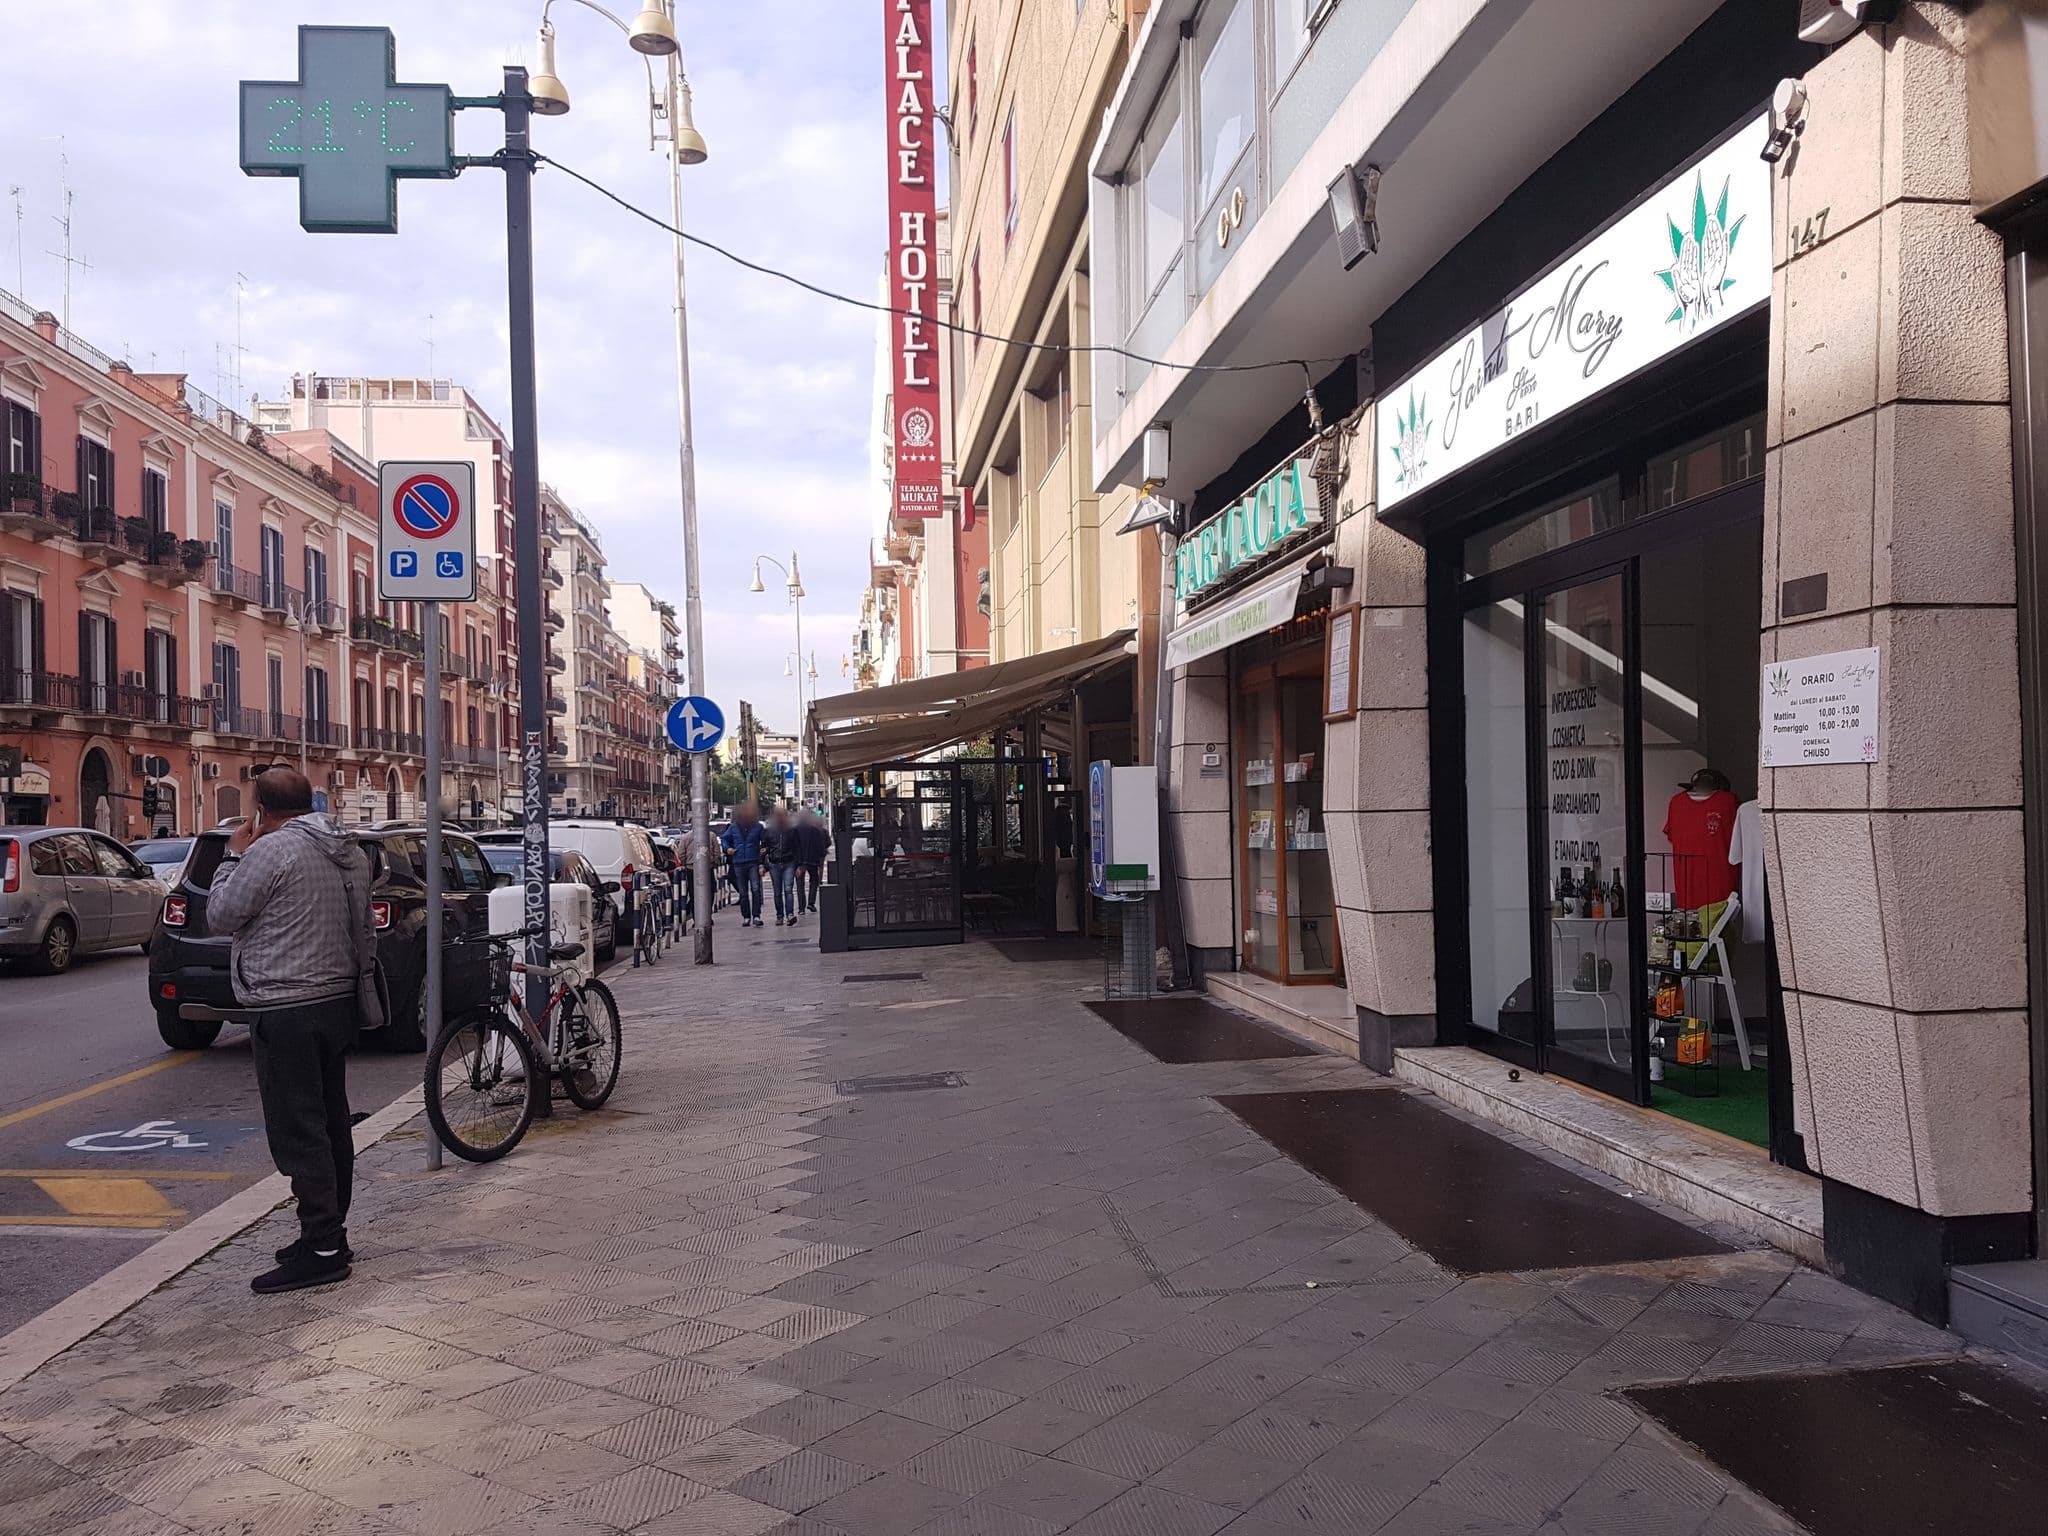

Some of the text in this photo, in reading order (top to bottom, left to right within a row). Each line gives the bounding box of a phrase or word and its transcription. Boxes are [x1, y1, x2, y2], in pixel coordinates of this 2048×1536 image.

[896, 0, 924, 184] ALACE
[1791, 207, 1830, 255] 147
[900, 212, 930, 385] HOTEL
[1529, 260, 1623, 379] Mary
[1505, 402, 1539, 437] BARI
[901, 492, 938, 502] MURAT
[1176, 458, 1307, 600] FARMACIA
[396, 554, 413, 574] P
[1801, 673, 1834, 685] ORARIO
[1552, 686, 1597, 714] INFIORESCENZE
[1825, 694, 1846, 702] SABATO
[1774, 712, 1796, 720] Mattina
[1819, 707, 1836, 718] 10,00
[1842, 705, 1860, 716] 13,00
[1552, 724, 1586, 748] COSMETICA
[1774, 723, 1809, 734] Pomeriggio
[1819, 721, 1836, 732] 16,00
[1841, 718, 1860, 730] 21,00
[1803, 748, 1830, 758] CHIUSO
[1552, 756, 1597, 780] FOOD & DRINK
[1552, 792, 1600, 814] ABBIGLIAMENTO
[1555, 840, 1600, 862] E TANTO ALTRO
